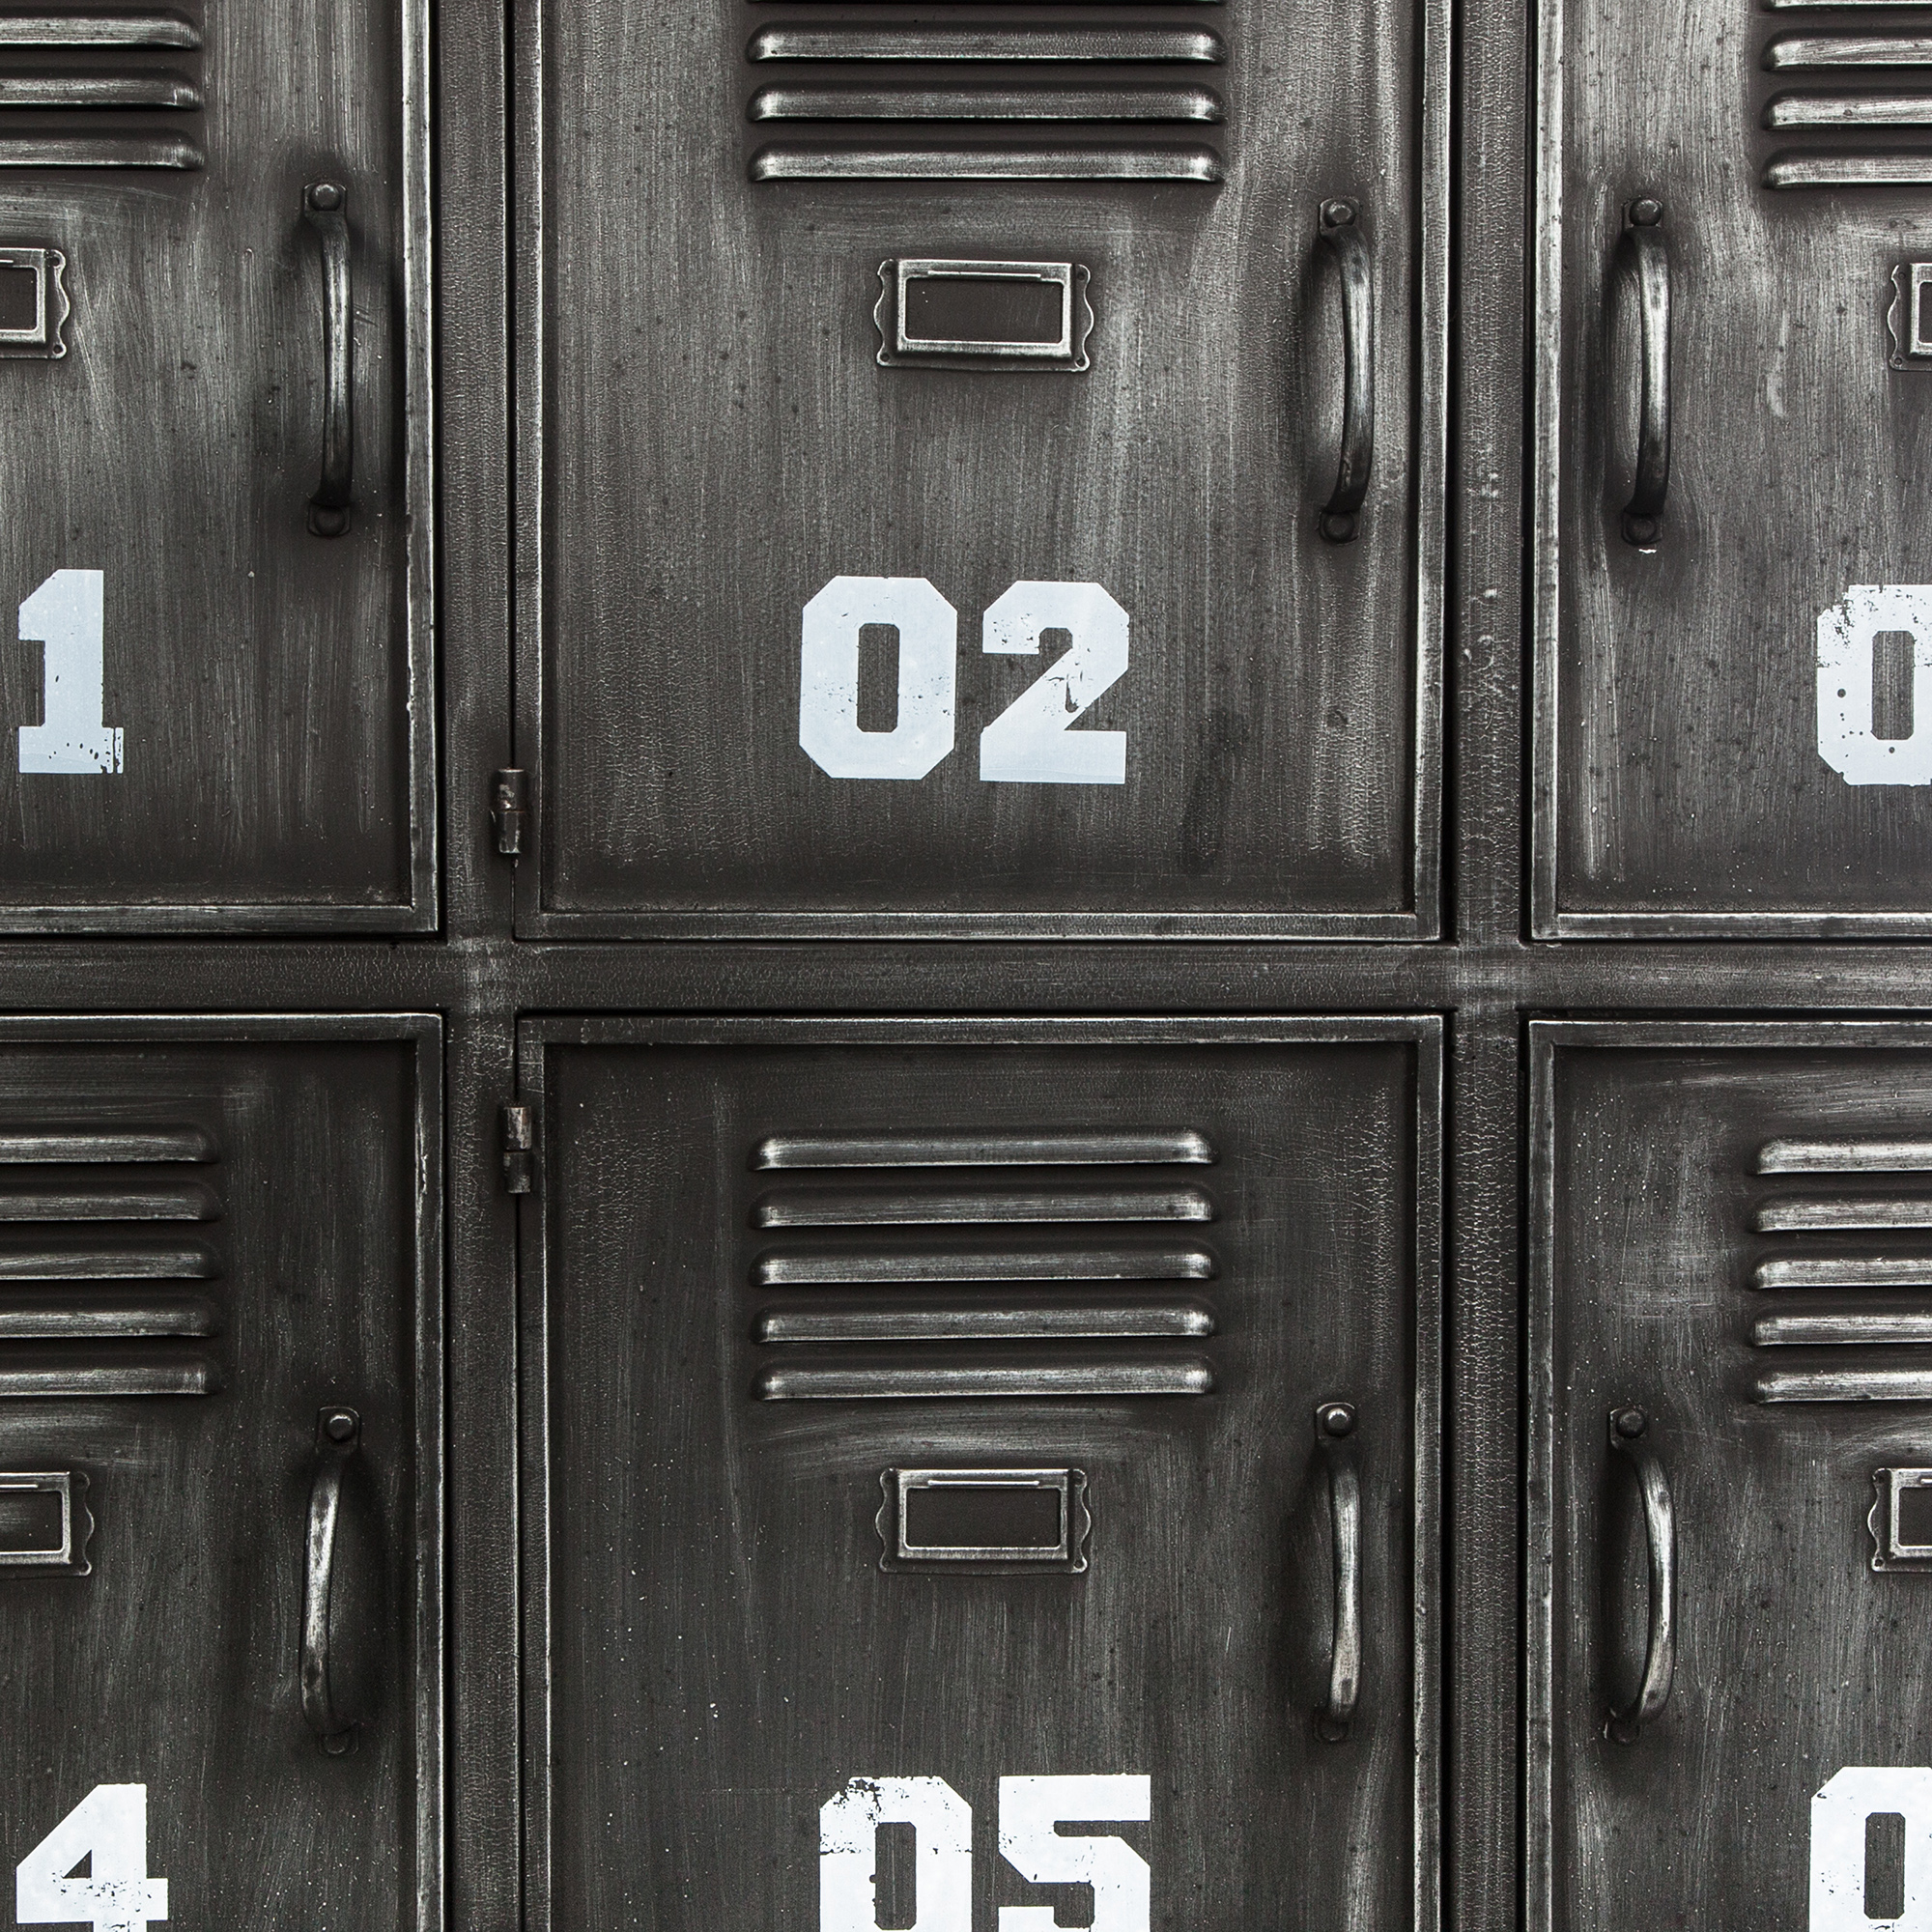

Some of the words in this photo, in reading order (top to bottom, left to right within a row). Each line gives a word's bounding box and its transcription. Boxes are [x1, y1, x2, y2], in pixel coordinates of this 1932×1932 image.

[17, 568, 125, 774] 1
[799, 575, 1130, 784] 02
[15, 1783, 169, 1932] 4
[819, 1774, 1151, 1932] 05
